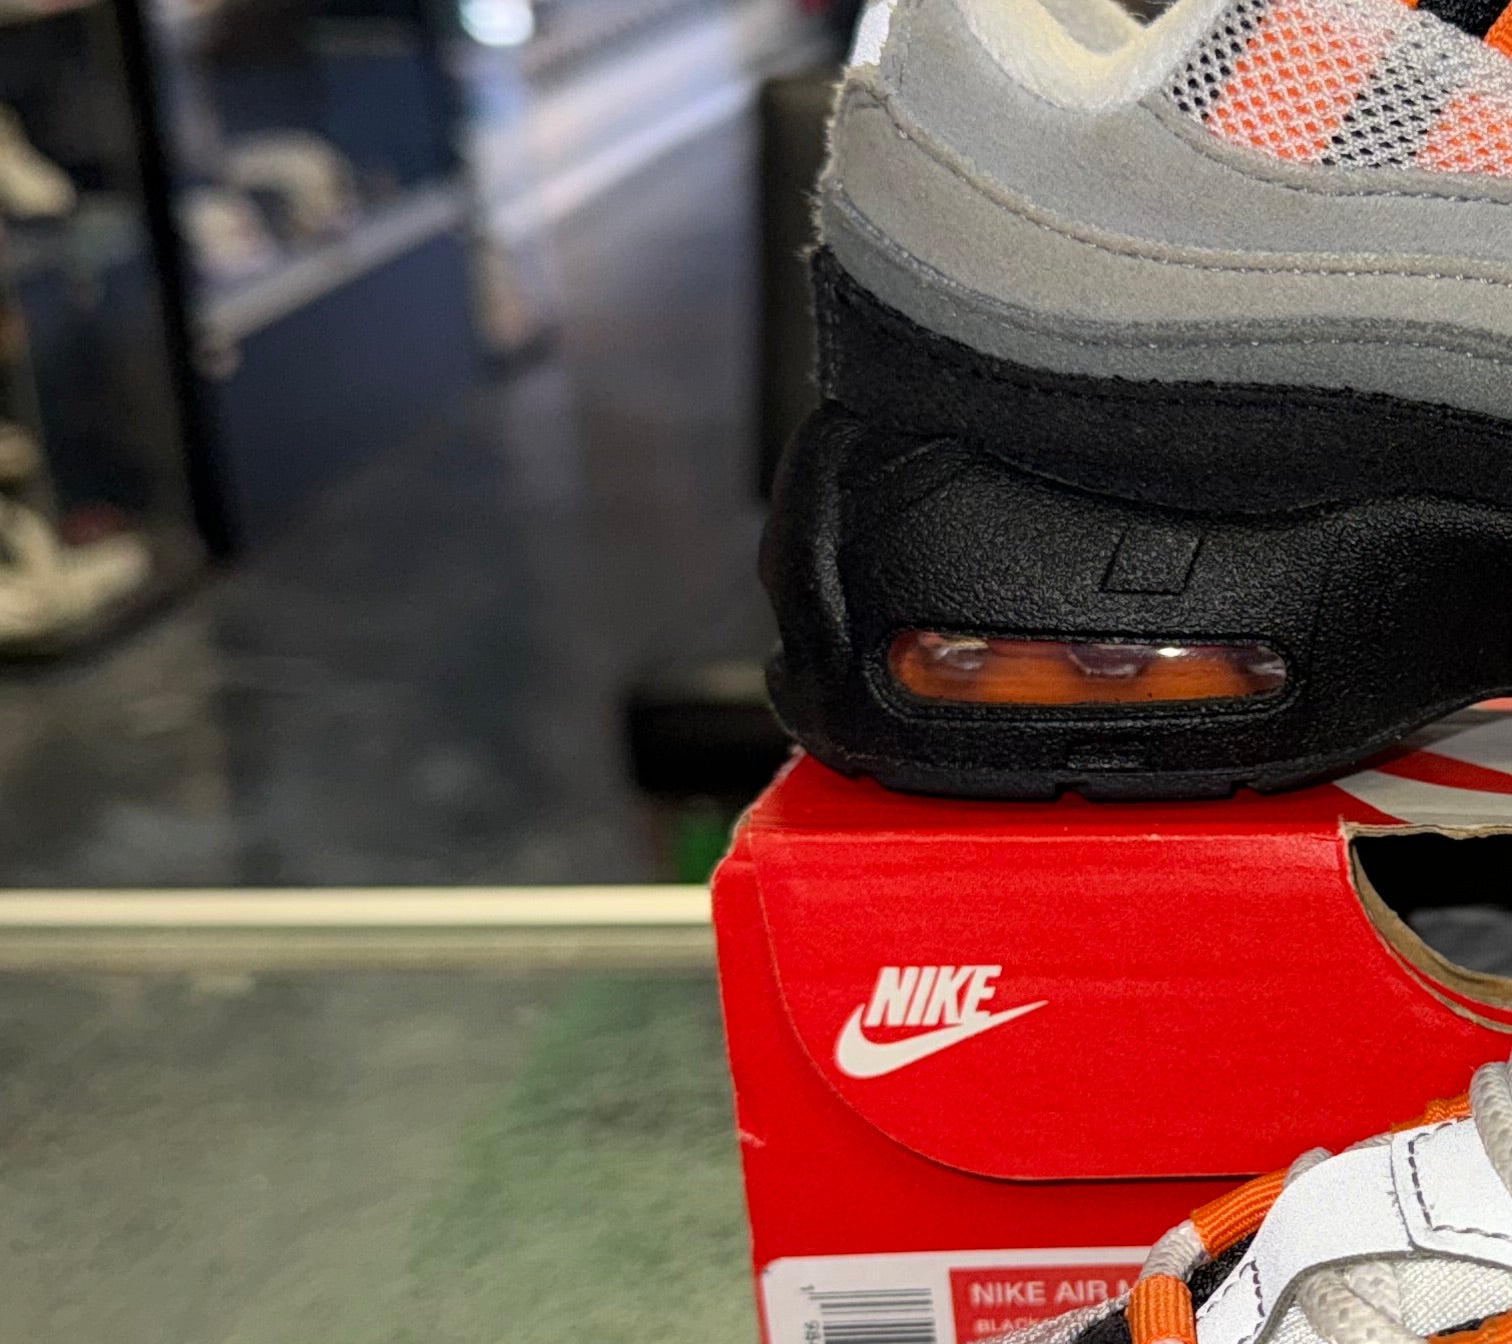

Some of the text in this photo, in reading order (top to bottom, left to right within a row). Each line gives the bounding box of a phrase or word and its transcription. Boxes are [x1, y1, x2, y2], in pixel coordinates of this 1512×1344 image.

[864, 965, 1002, 1027] NIKE
[969, 1280, 1046, 1305] NIKE
[1055, 1279, 1108, 1304] AIR
